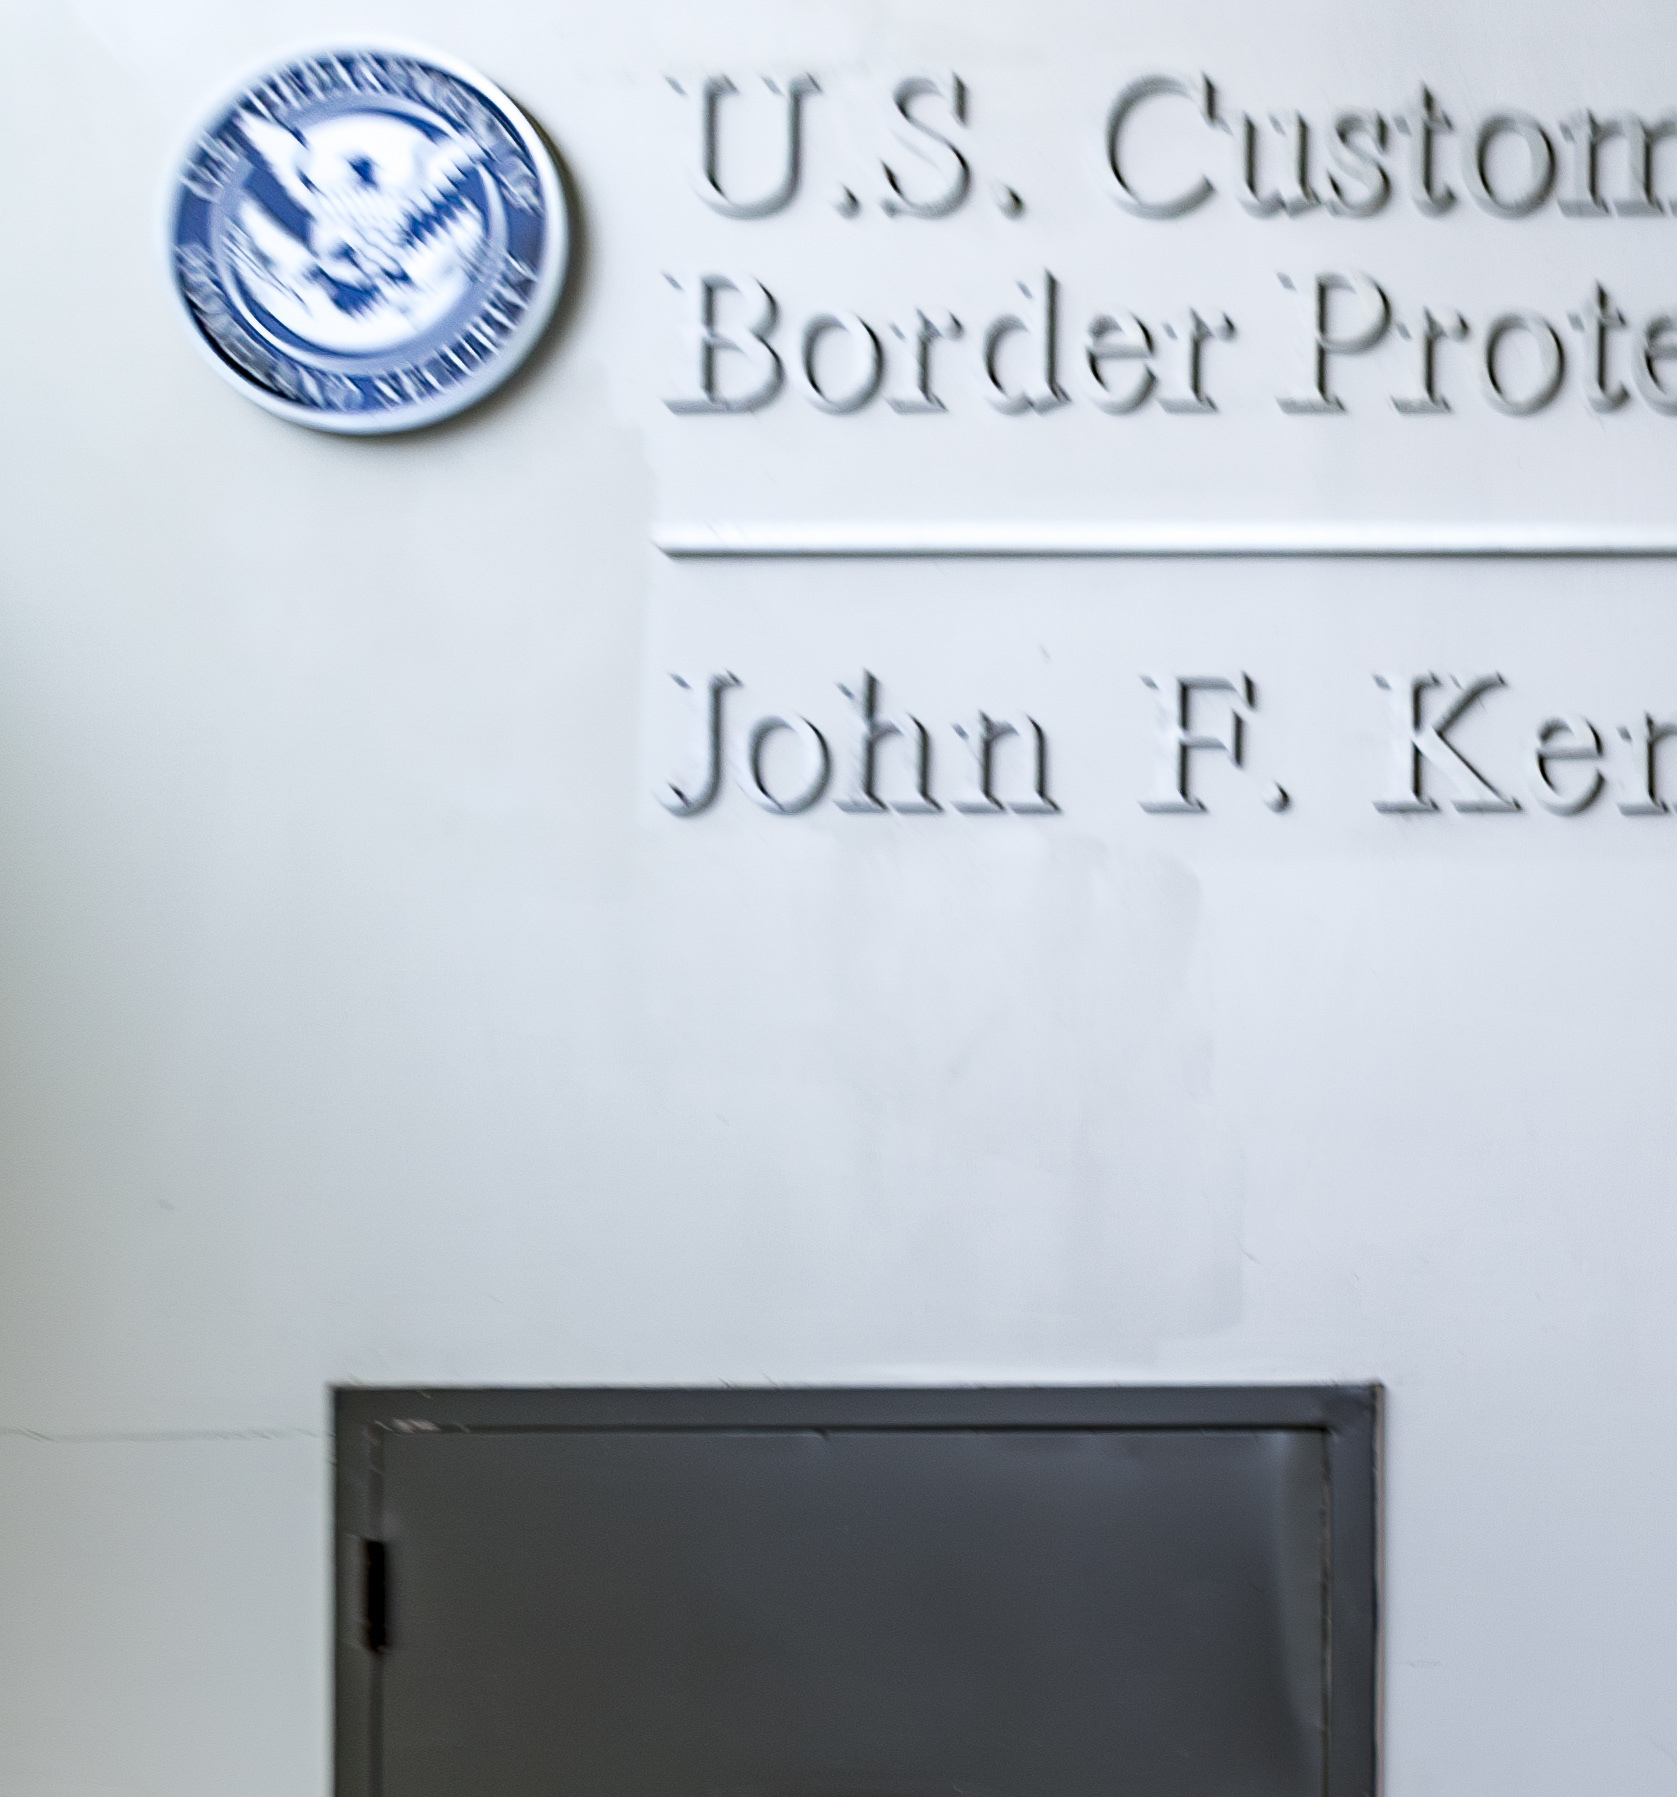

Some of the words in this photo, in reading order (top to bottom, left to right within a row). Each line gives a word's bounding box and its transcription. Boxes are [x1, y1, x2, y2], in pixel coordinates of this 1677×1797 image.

[665, 72, 1028, 220] U.S.
[662, 271, 1238, 415] Border
[660, 670, 1060, 820] John
[1140, 670, 1291, 815] F.
